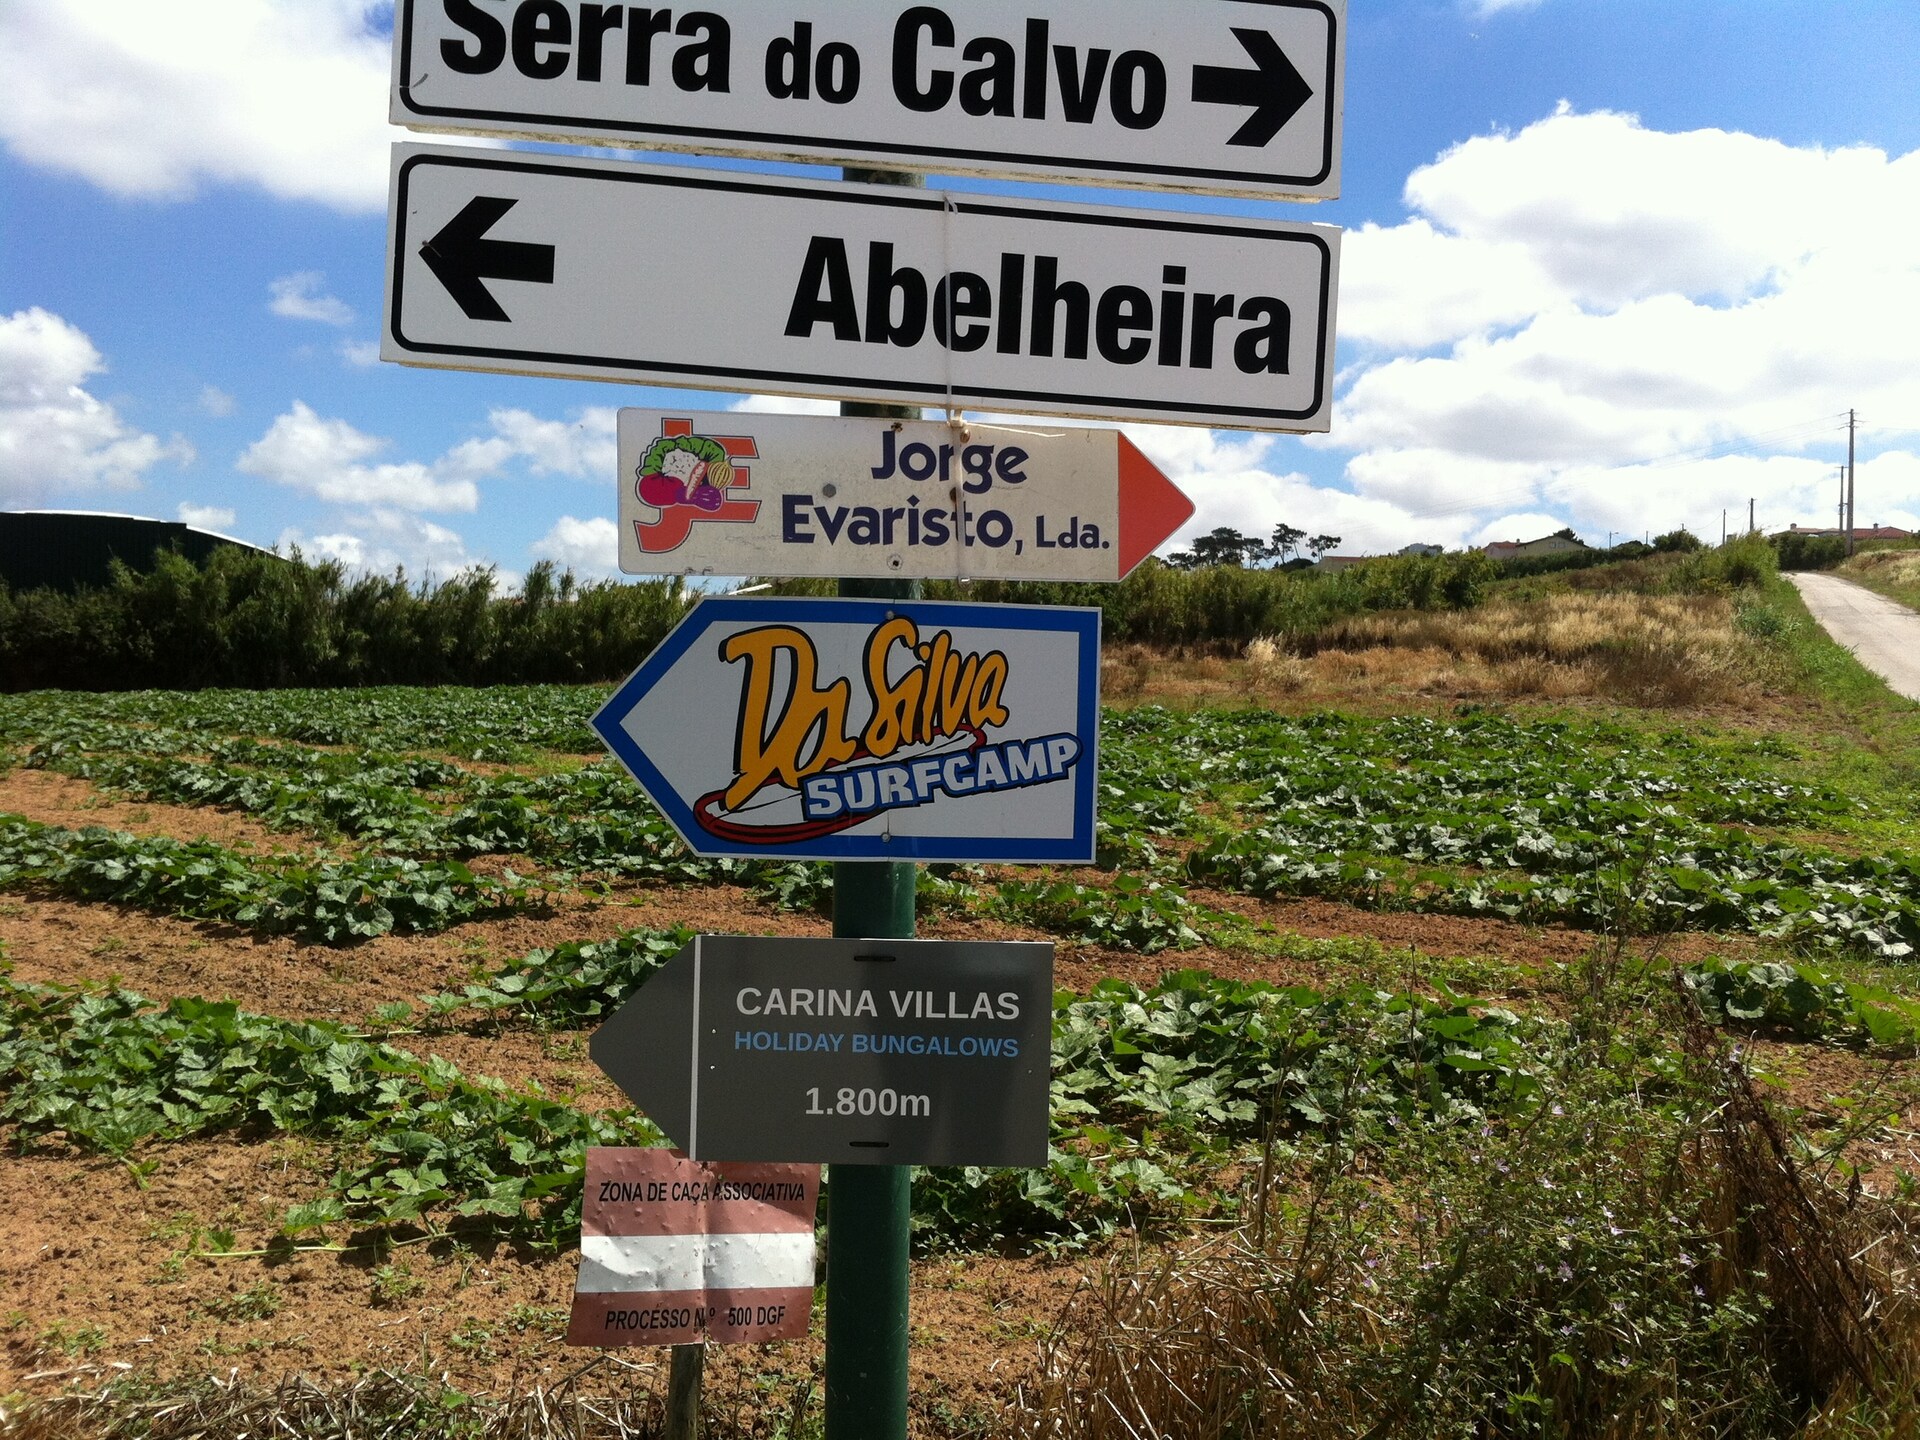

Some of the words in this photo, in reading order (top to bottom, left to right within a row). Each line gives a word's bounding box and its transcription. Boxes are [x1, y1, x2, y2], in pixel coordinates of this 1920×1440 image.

[440, 0, 731, 93] Serra
[765, 22, 861, 104] do
[891, 6, 1167, 129] Calvo
[784, 236, 1290, 375] Abelheira
[871, 430, 1029, 494] Jorge
[782, 494, 1023, 555] Evaristo,
[1036, 516, 1110, 550] Lda.
[718, 625, 857, 811] Da
[862, 615, 1009, 758] Silva
[805, 736, 1080, 817] SURFCAMP
[735, 987, 879, 1018] CARINA
[888, 989, 1021, 1020] VILLAS
[734, 1031, 844, 1053] HOLIDAY
[851, 1034, 1020, 1058] BUNGALOWS
[804, 1086, 931, 1118] 1.800m
[599, 1181, 643, 1202] ZONA
[647, 1182, 668, 1201] DE
[671, 1181, 709, 1205] CAÇA
[712, 1181, 805, 1201] ASSOCIATIVA
[604, 1308, 691, 1330] PROCESSO
[727, 1306, 752, 1327] 500
[756, 1305, 786, 1326] DGF
